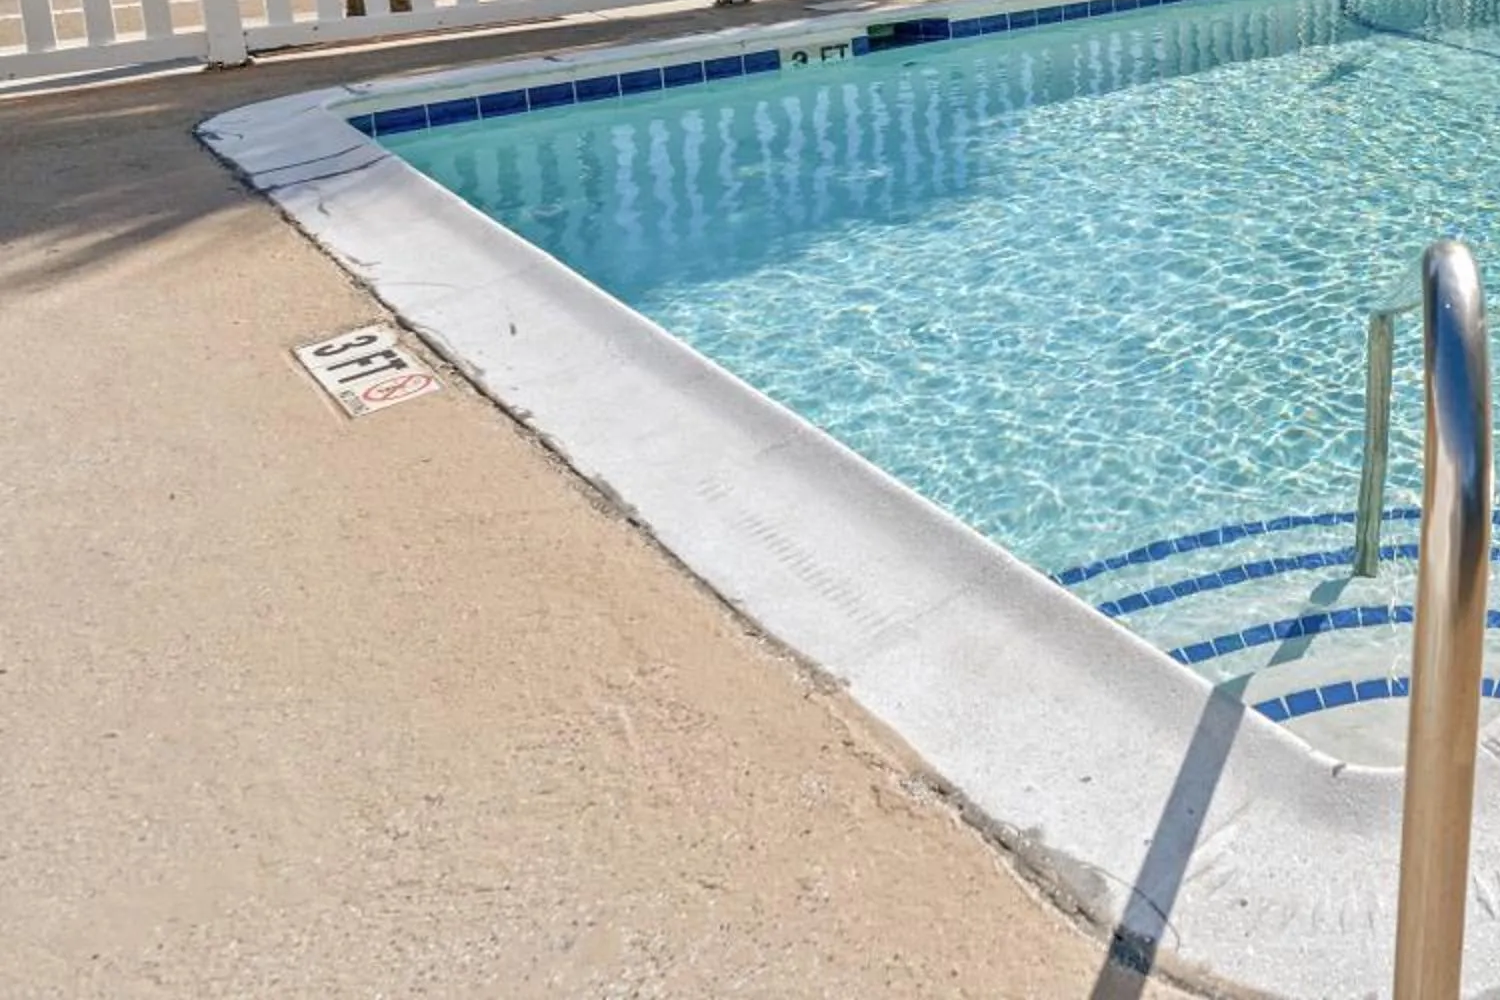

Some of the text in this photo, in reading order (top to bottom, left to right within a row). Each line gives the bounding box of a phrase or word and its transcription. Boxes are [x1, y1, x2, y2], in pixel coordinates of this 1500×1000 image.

[820, 43, 849, 63] FT
[313, 334, 379, 357] 3
[325, 349, 408, 384] FT
